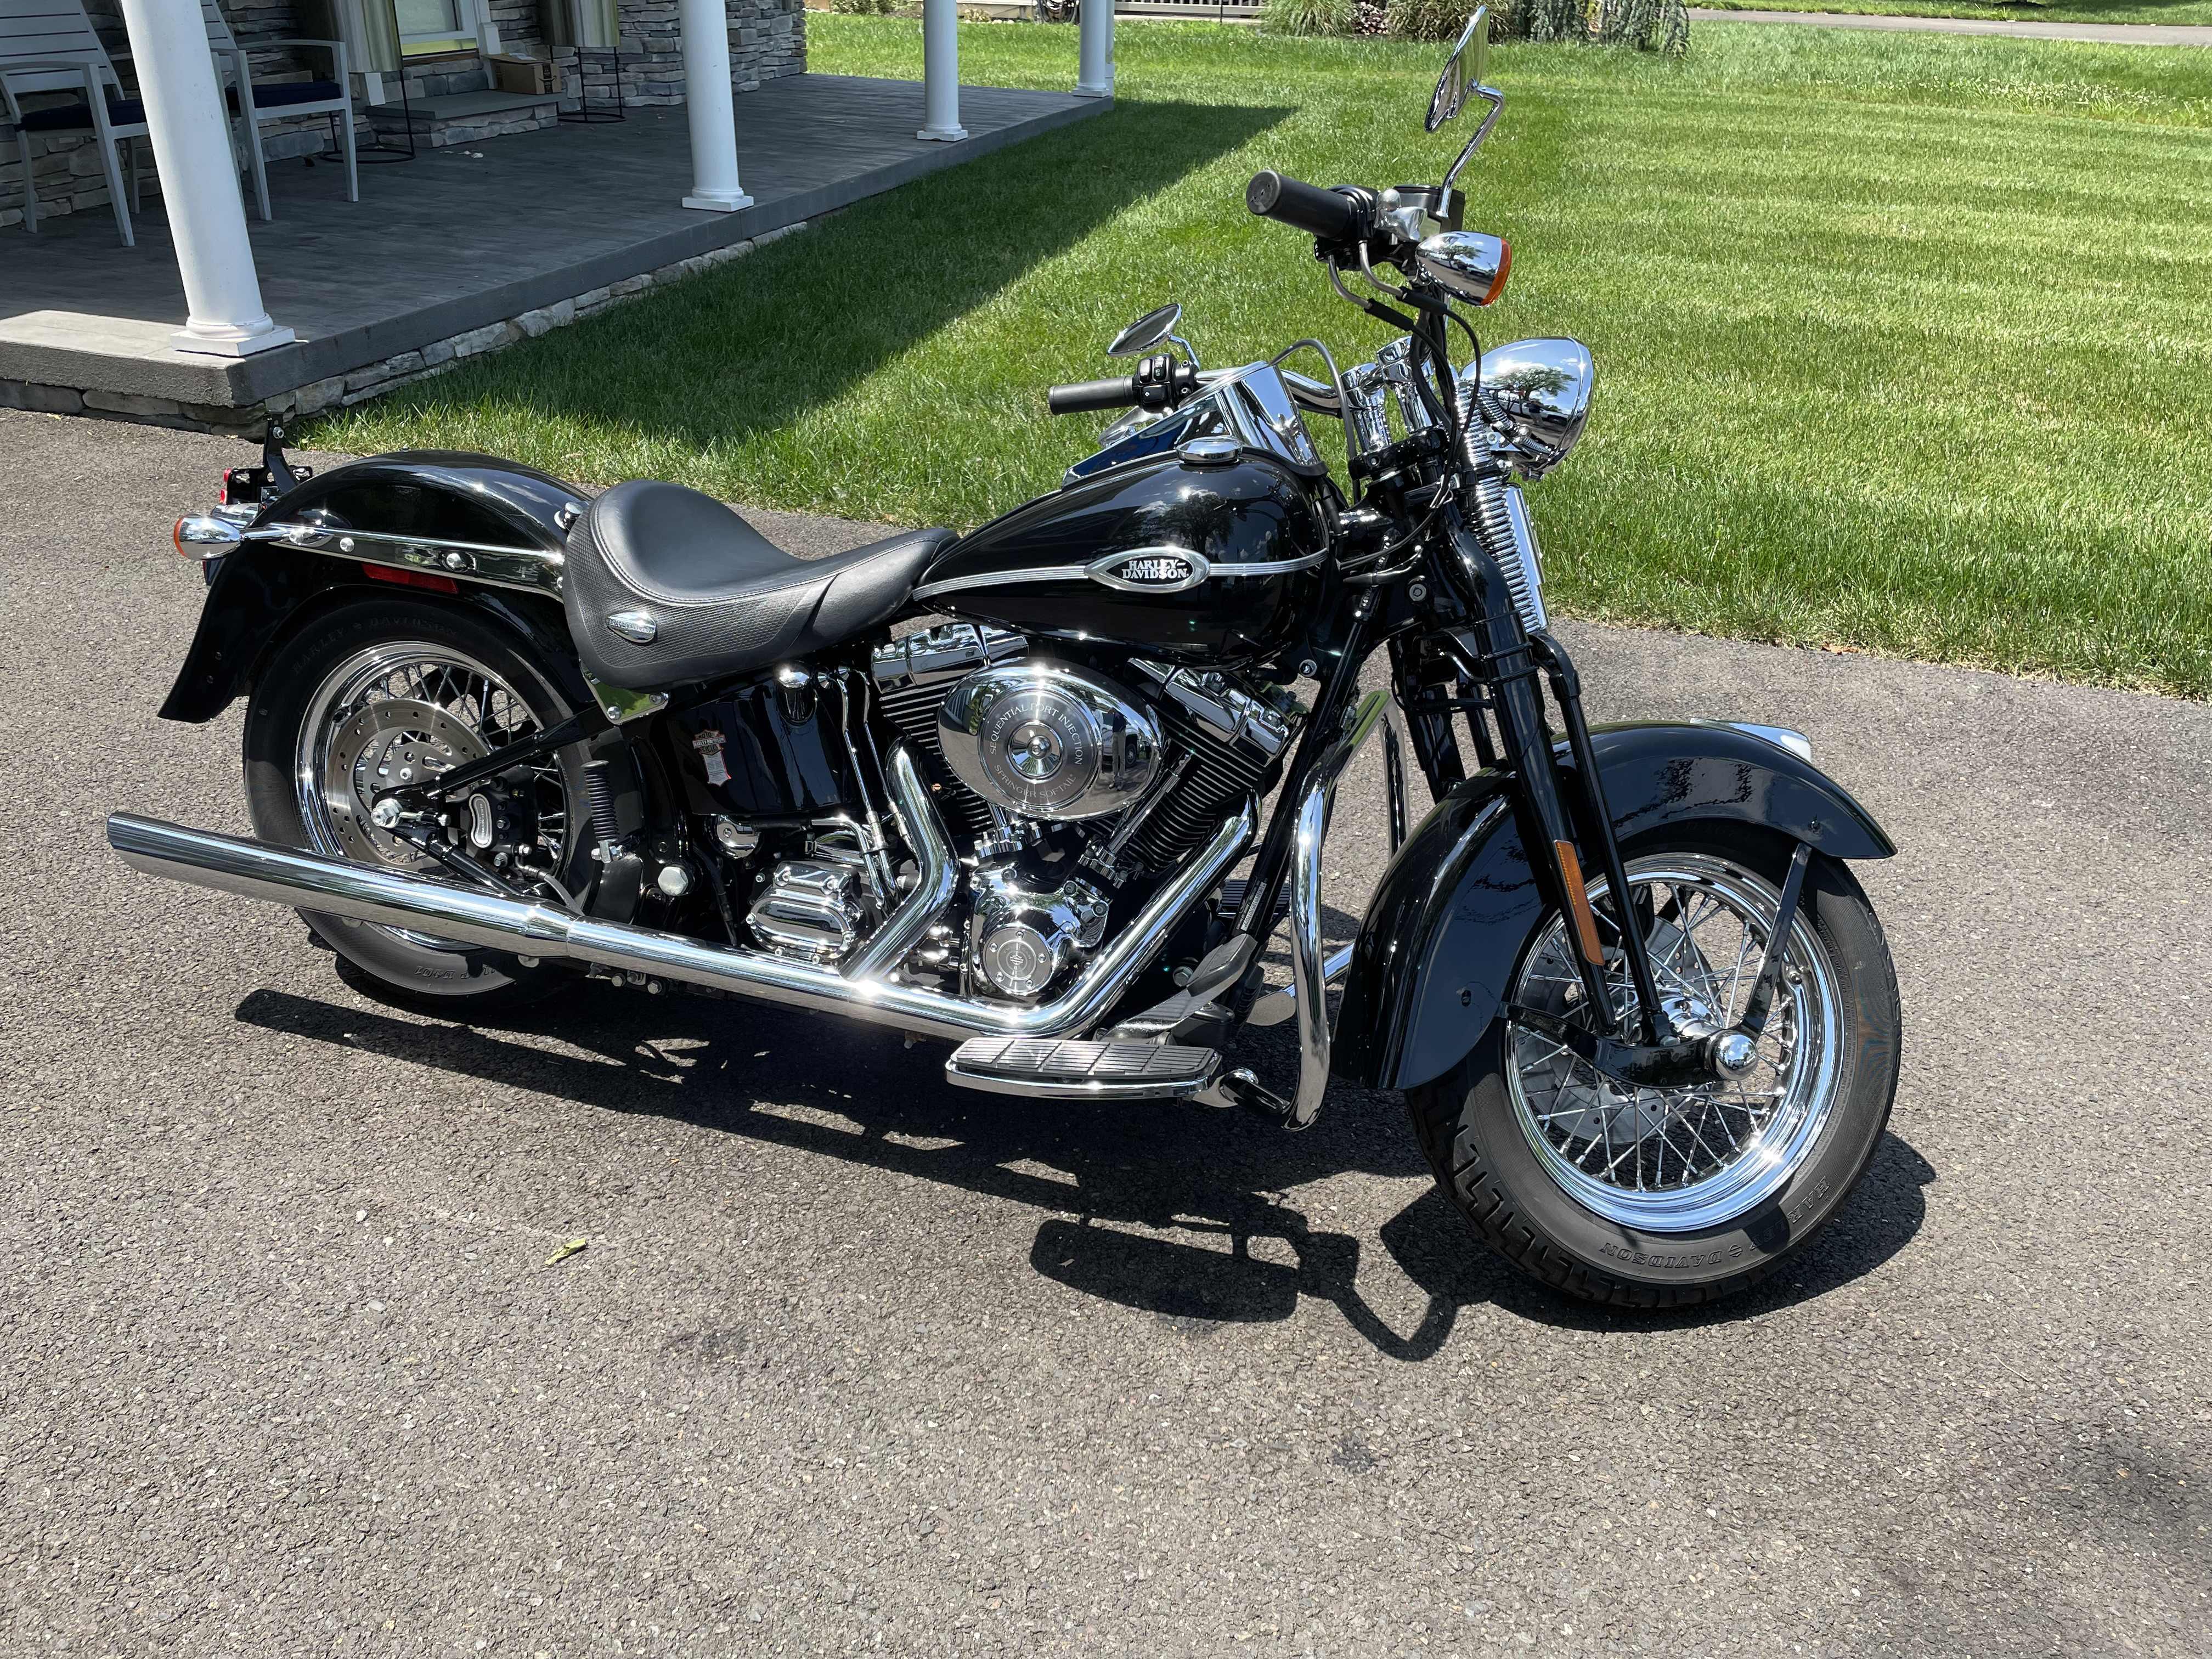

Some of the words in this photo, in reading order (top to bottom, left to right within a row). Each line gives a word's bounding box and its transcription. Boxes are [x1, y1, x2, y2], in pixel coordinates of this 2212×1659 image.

[1121, 568, 1189, 579] DAVIDSON
[1128, 558, 1186, 570] HARLEY-
[291, 626, 345, 676] HARLEY
[369, 616, 457, 637] DAVIDSON
[990, 704, 1028, 755] SEQUENTIAL
[1030, 702, 1059, 716] PORT
[1058, 714, 1084, 766] INJECTION
[994, 764, 1036, 798] SPRINGER
[1039, 775, 1076, 798] SOFTAIL
[414, 964, 454, 980] D401
[1748, 1175, 1831, 1251] HARLEY
[1598, 1242, 1723, 1268] DAVIDSON
